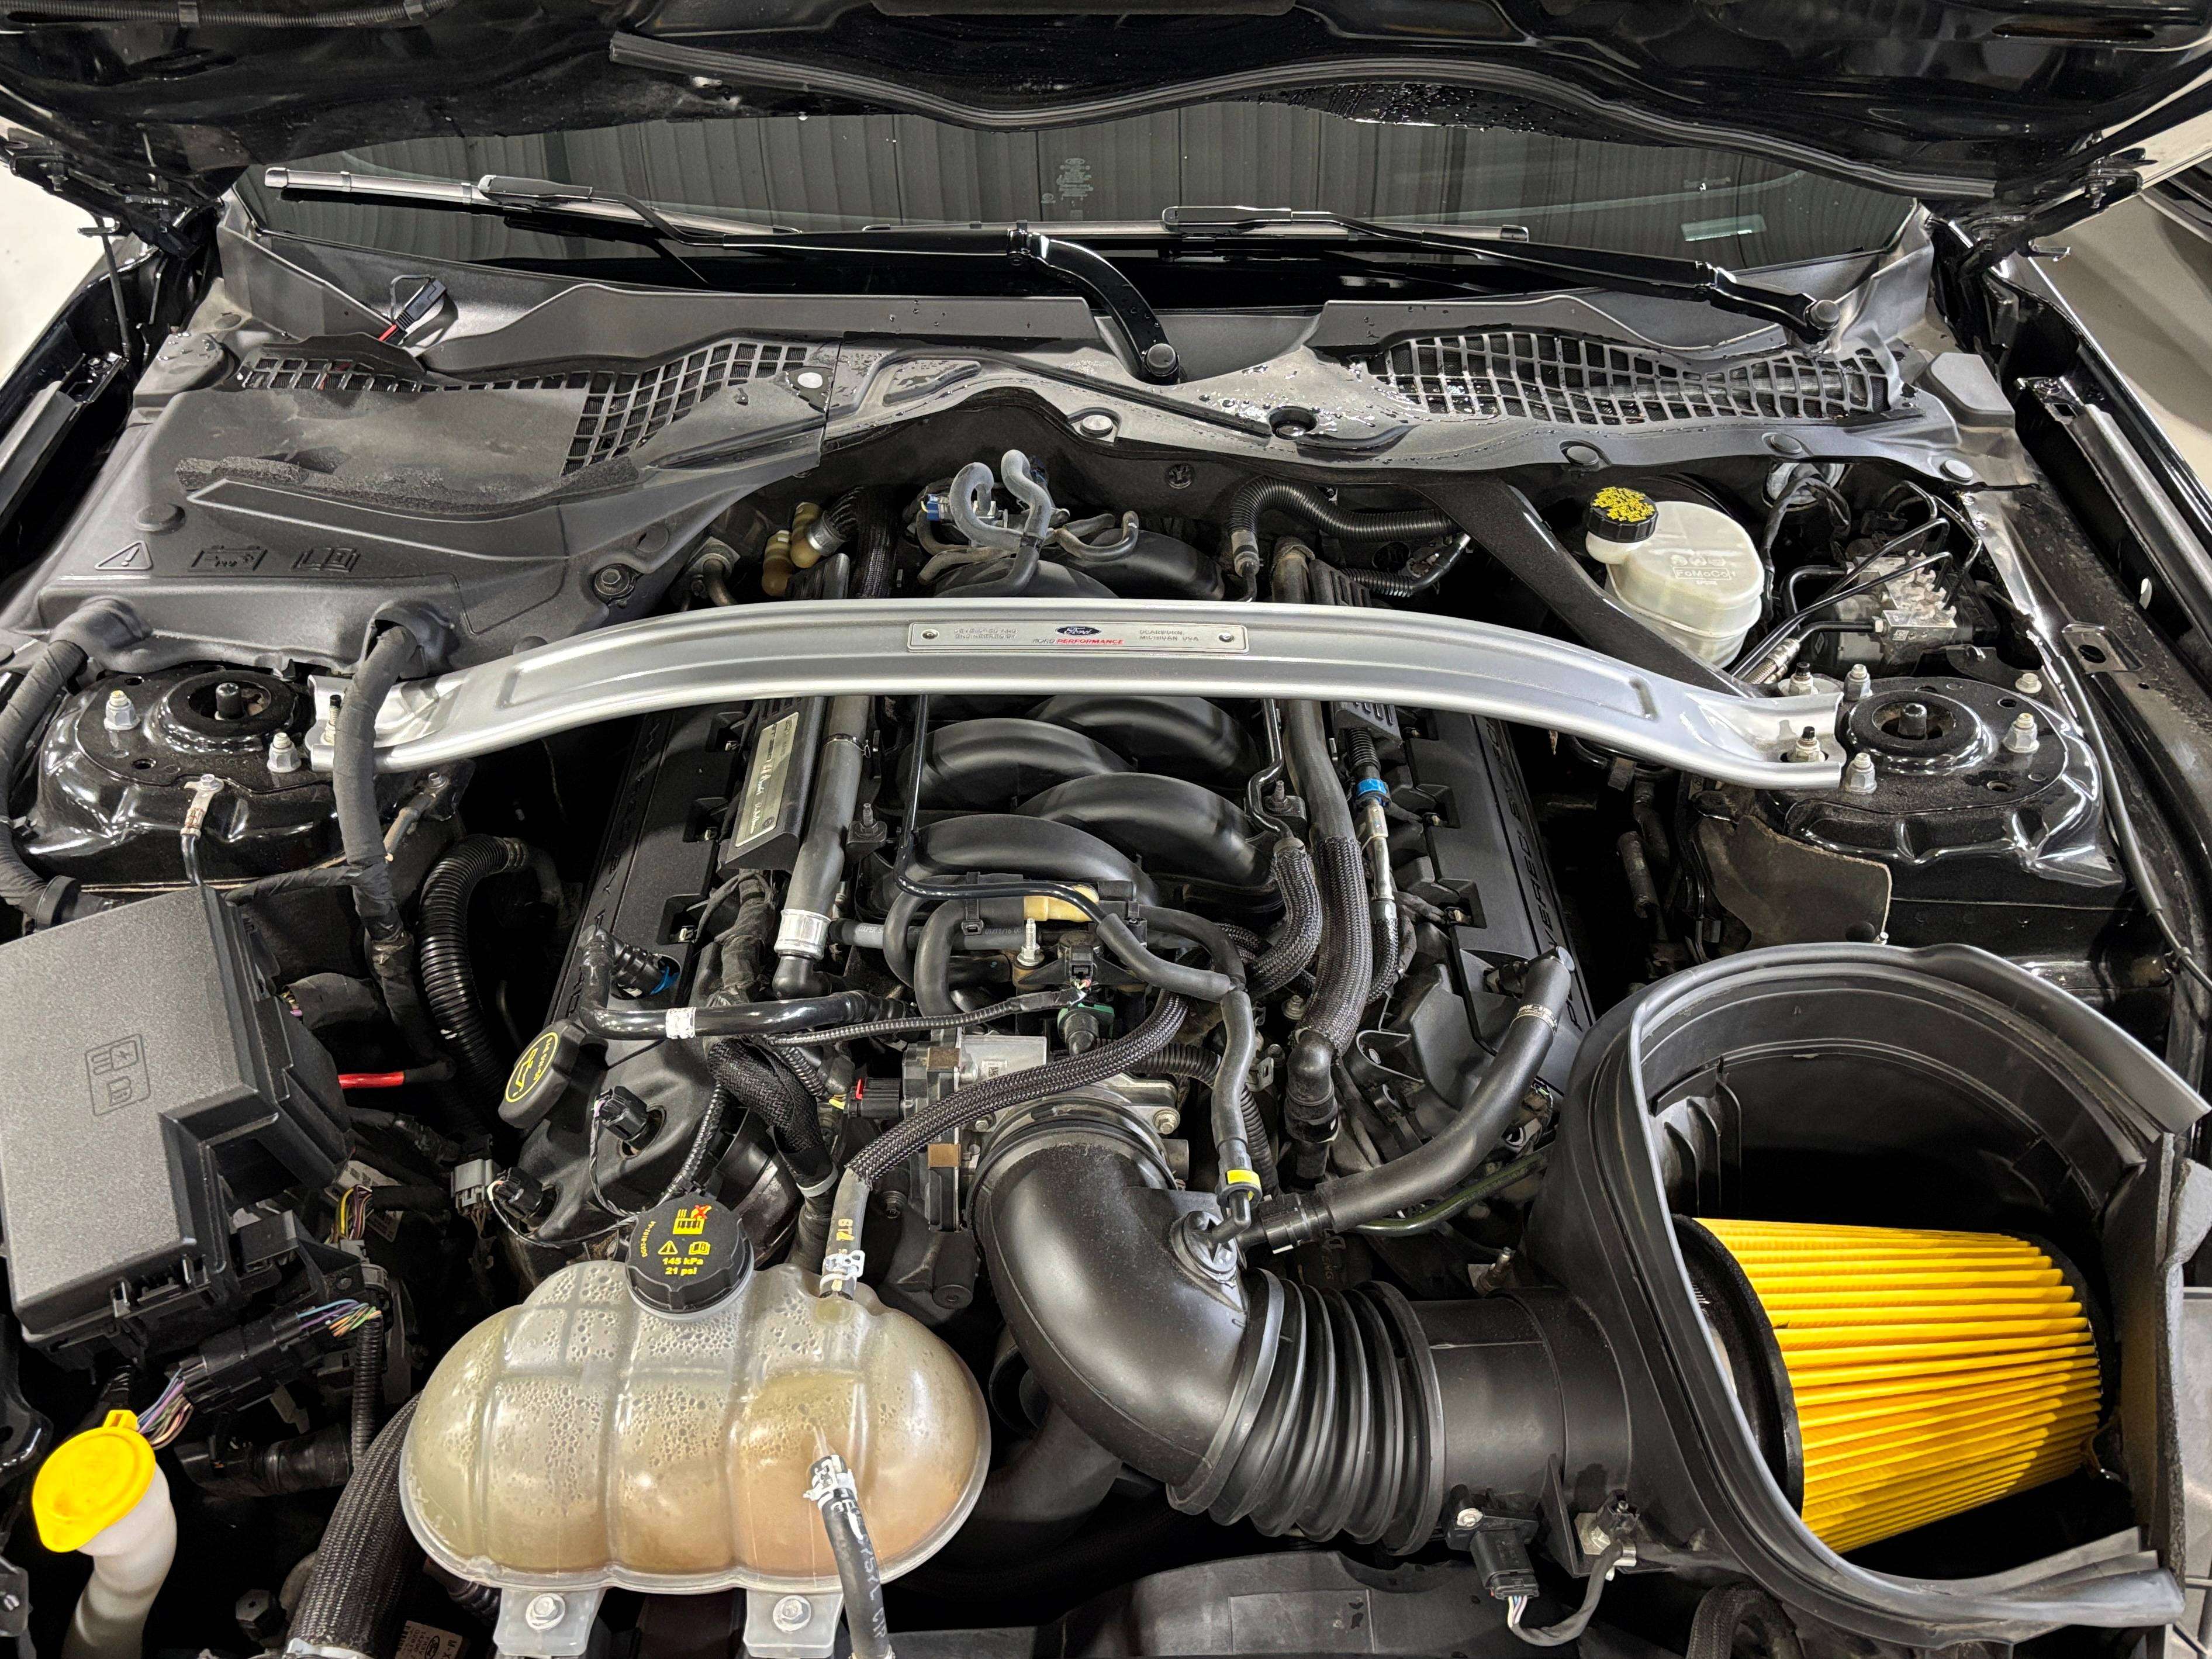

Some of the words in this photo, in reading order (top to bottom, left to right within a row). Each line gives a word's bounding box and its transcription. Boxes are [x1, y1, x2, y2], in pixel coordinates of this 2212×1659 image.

[1675, 569, 1728, 578] FoMoCo
[683, 1257, 704, 1265] kPa
[665, 1267, 679, 1275] 21
[680, 1267, 697, 1276] psi
